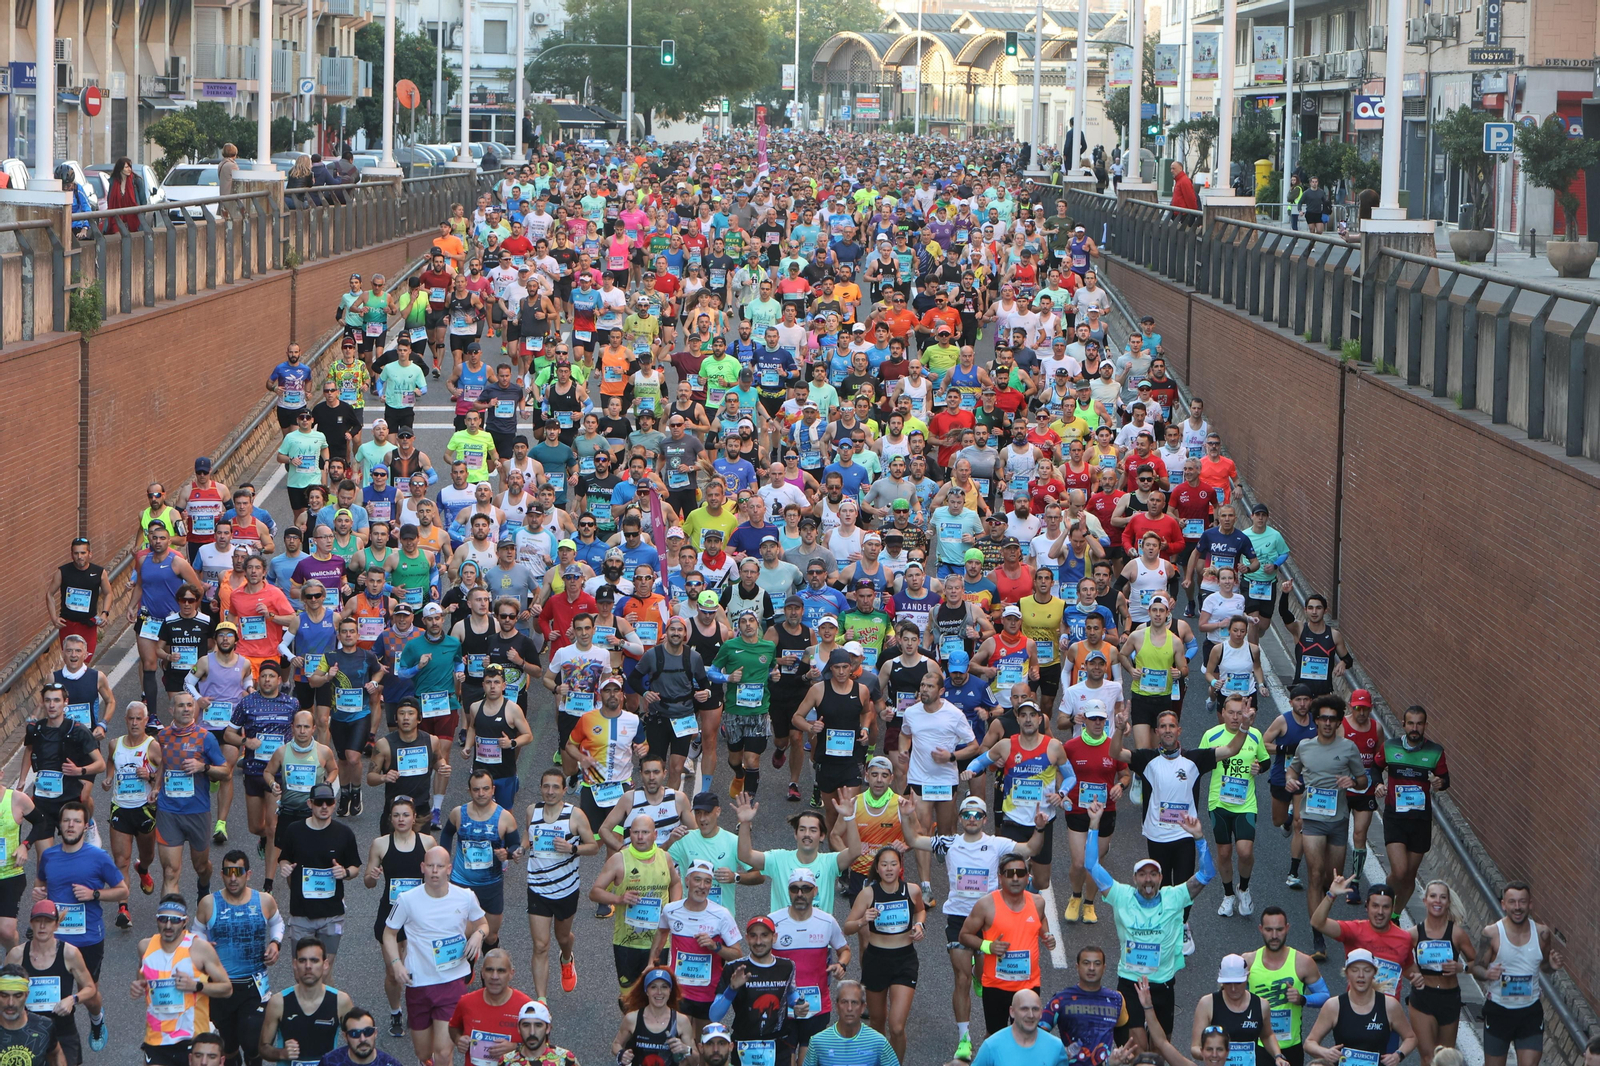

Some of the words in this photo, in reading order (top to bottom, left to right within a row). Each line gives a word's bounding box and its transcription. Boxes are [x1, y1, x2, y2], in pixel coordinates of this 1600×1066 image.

[1473, 52, 1511, 61] HOSTAL
[1545, 59, 1593, 67] BENIDOR
[1490, 127, 1509, 150] P
[1211, 543, 1227, 552] RAC
[444, 937, 462, 945] ZURICH
[1380, 962, 1398, 970] ZURICH
[636, 1042, 669, 1050] PARMARATHO
[1354, 1052, 1374, 1060] ZURICH
